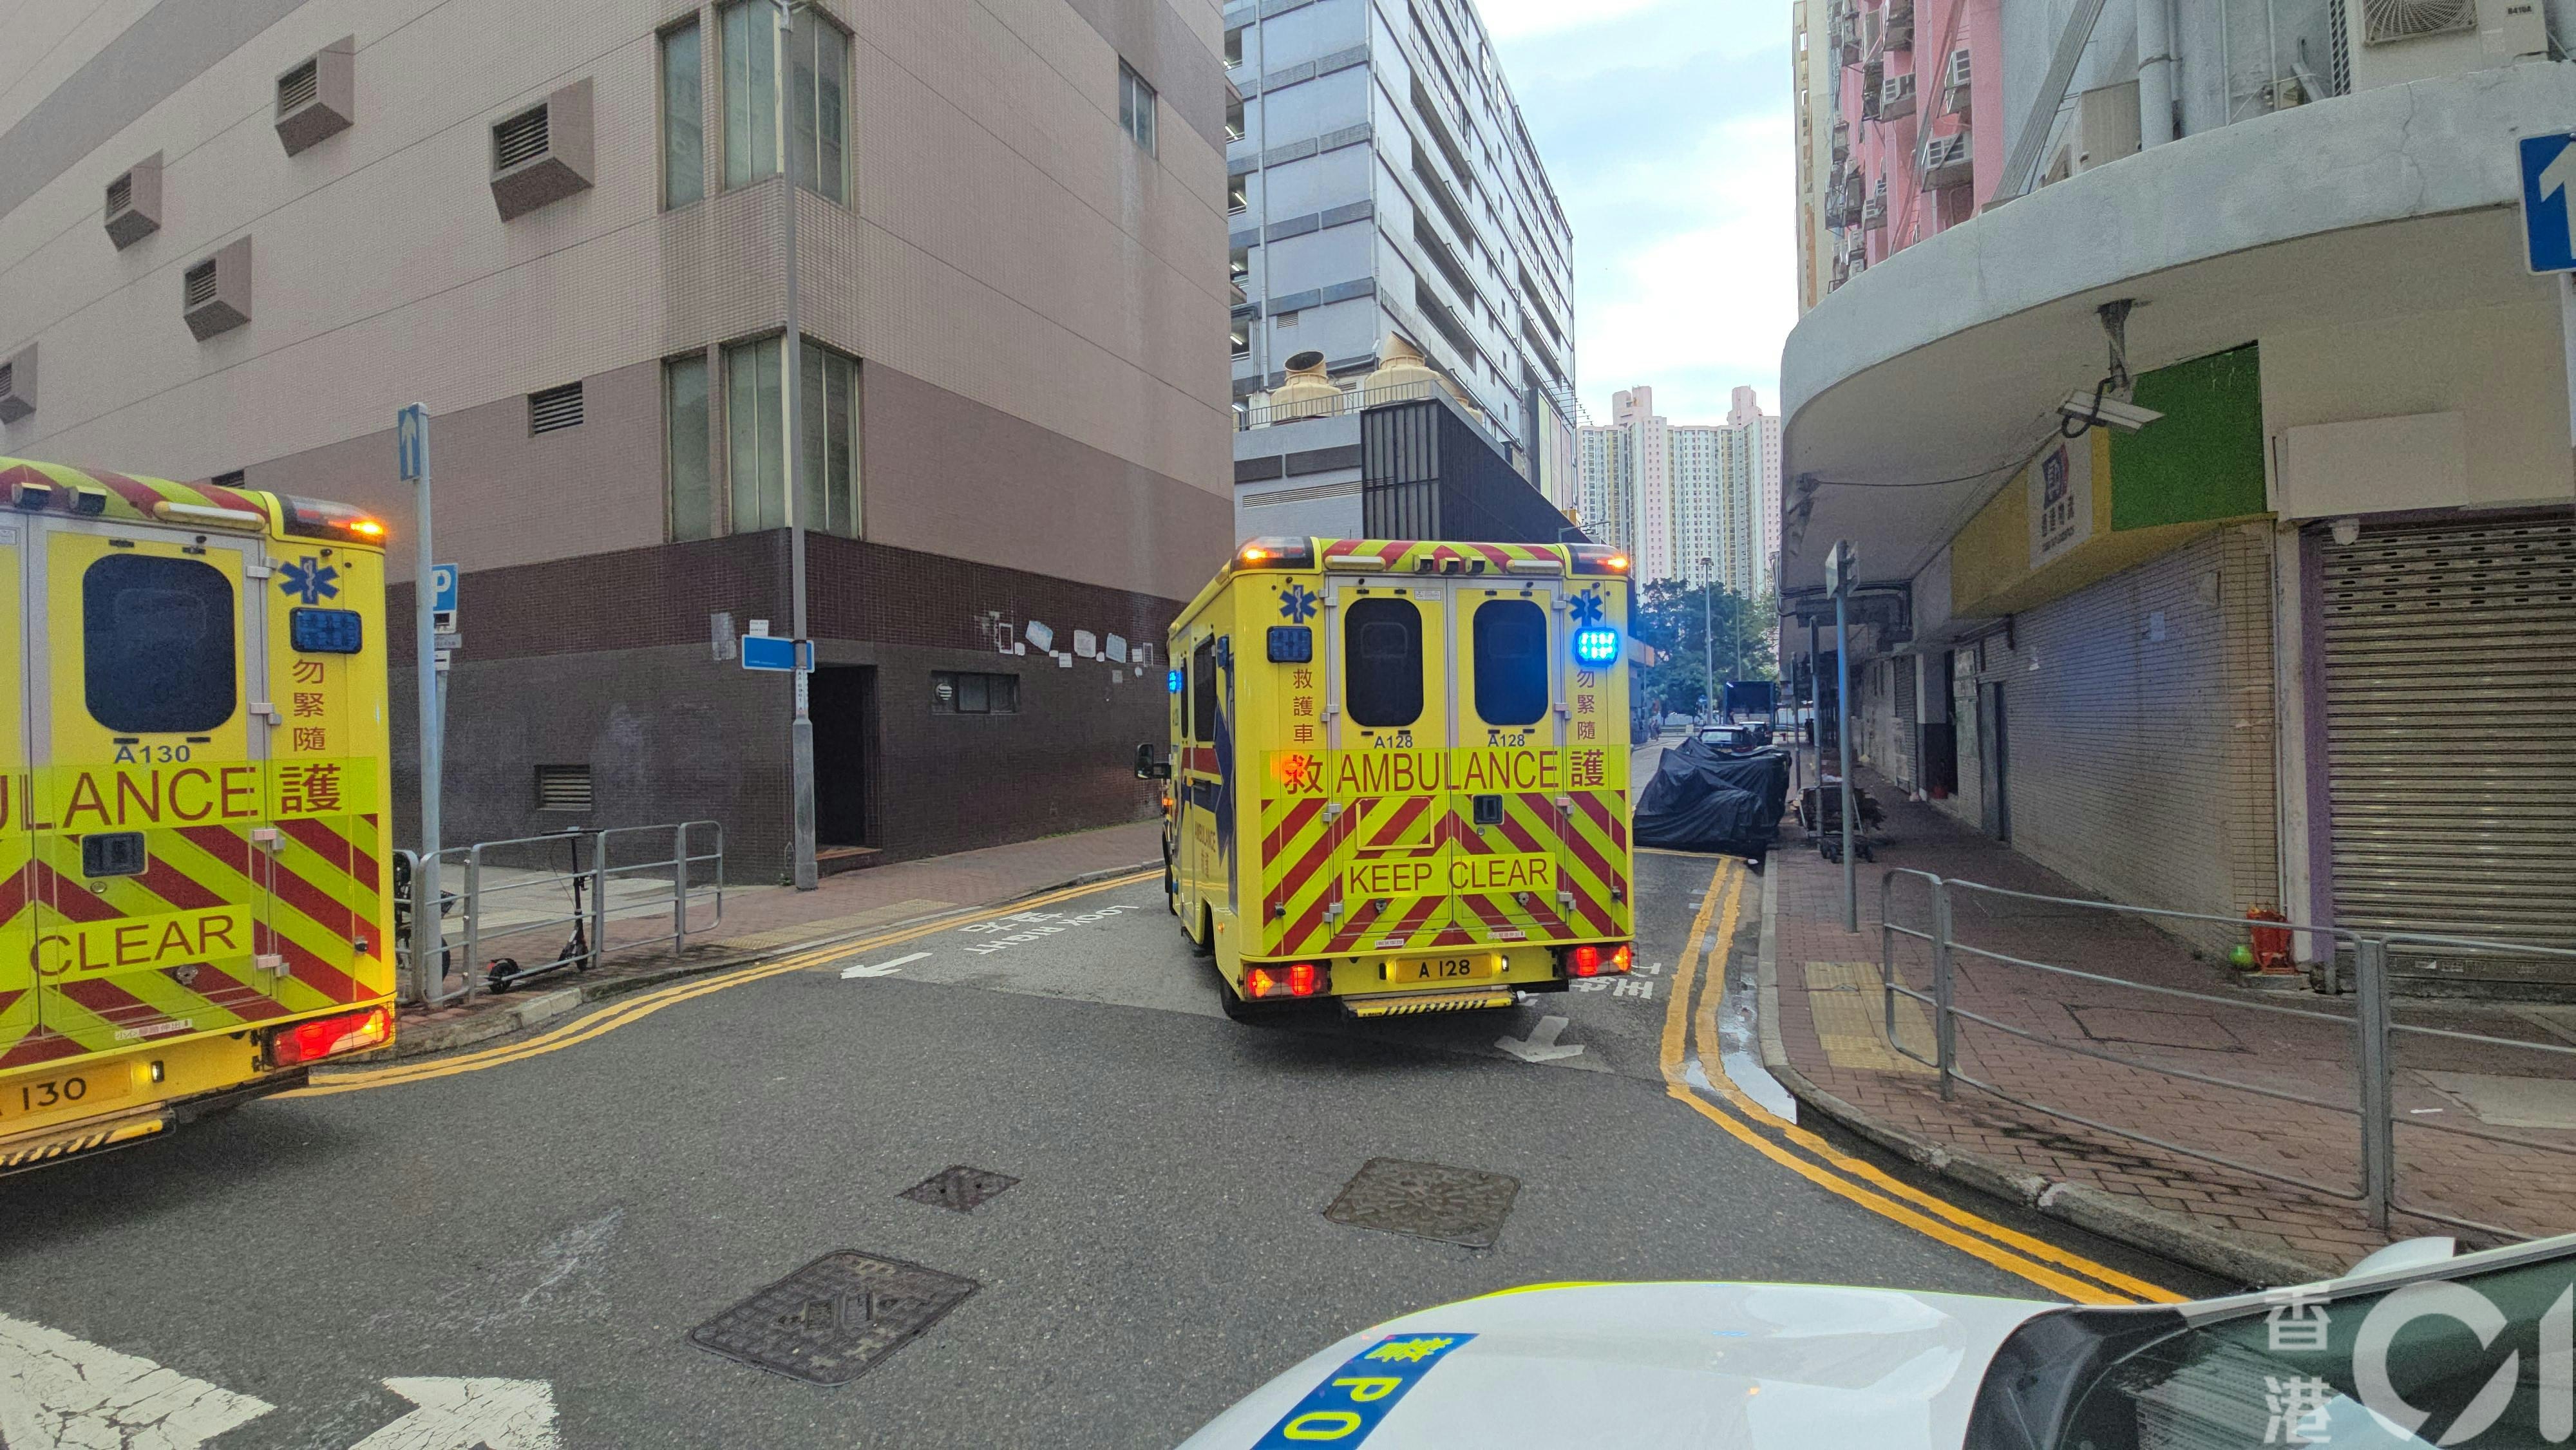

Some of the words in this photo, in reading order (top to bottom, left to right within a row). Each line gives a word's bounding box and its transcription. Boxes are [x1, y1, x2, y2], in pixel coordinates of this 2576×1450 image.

[432, 569, 451, 607] P
[292, 659, 326, 752] 勿緊隨
[1293, 668, 1314, 744] 救護車
[1577, 668, 1596, 740] 勿緊隨
[114, 744, 191, 764] A130
[1374, 735, 1414, 749] A128
[1487, 733, 1525, 748] A128
[1283, 754, 1324, 795] 救
[1337, 749, 1558, 793] AMBULANCE
[1569, 748, 1605, 787] 護
[0, 766, 259, 832] LANCE
[278, 763, 343, 814] 護
[1350, 863, 1433, 894] KEEP
[1448, 858, 1549, 890] CLEAR
[1056, 905, 1139, 926] LOOK
[30, 914, 237, 977] CLEAR
[963, 927, 1066, 955] RIGHT
[1419, 962, 1430, 978] A
[1439, 959, 1471, 977] 128
[23, 1077, 87, 1111] 130
